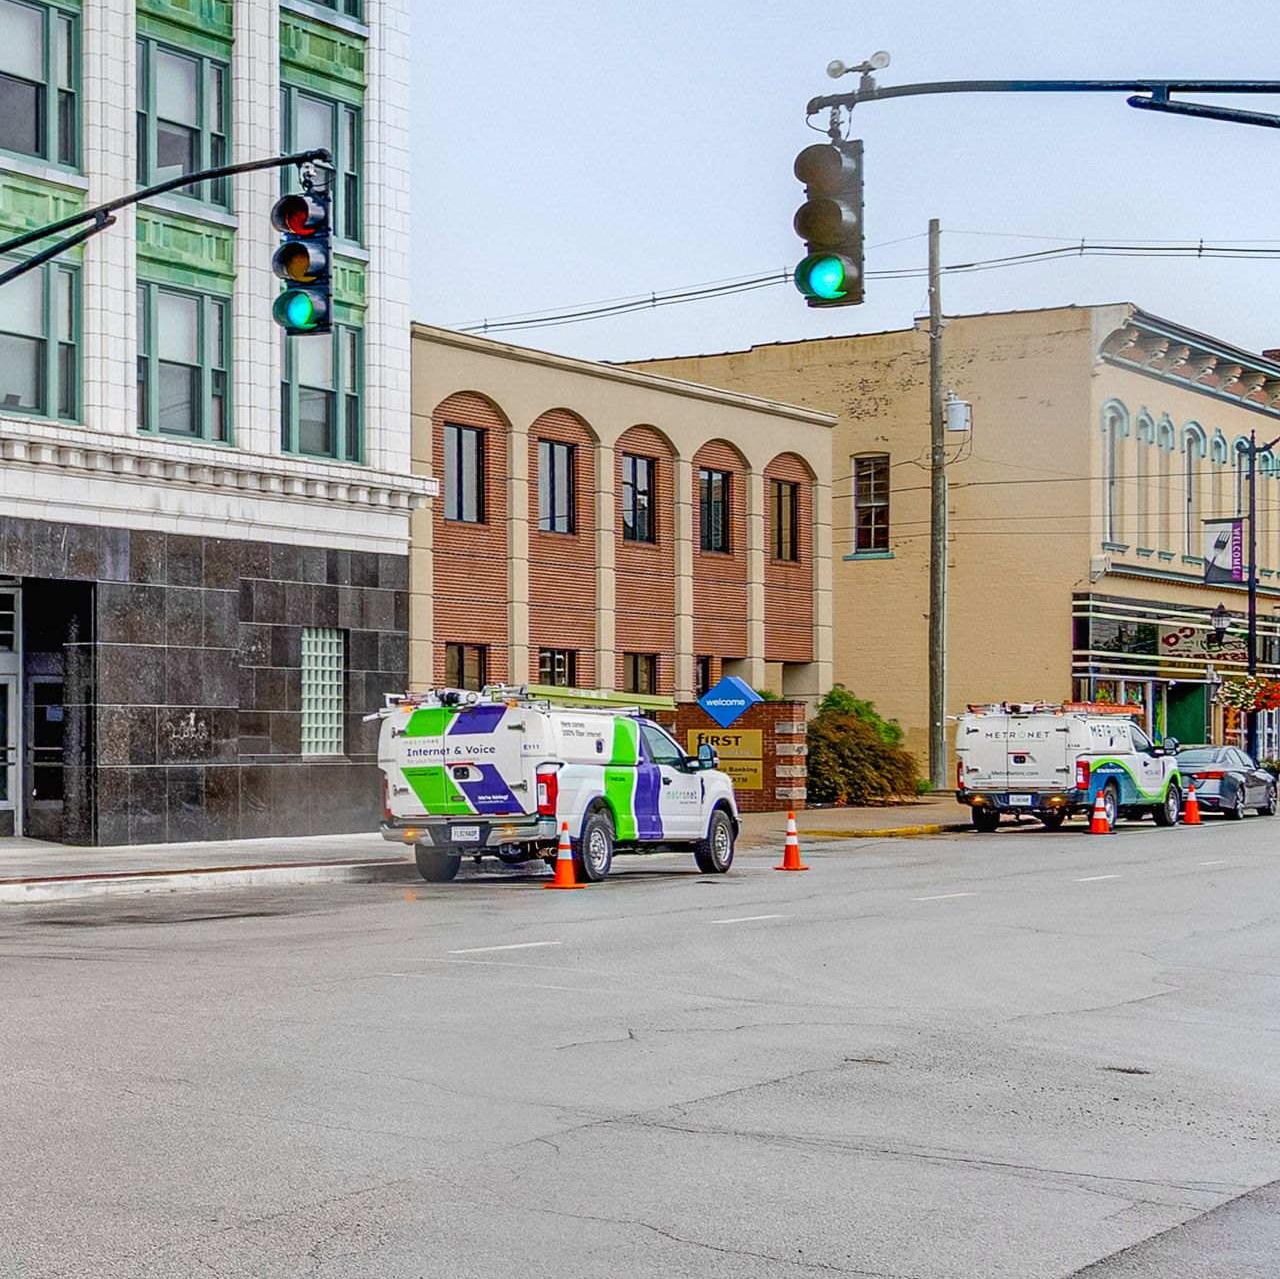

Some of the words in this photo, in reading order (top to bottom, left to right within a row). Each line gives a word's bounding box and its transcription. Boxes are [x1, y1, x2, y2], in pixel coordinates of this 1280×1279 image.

[706, 698, 746, 707] welcome
[985, 731, 1050, 739] METRONET
[407, 748, 450, 757] Internet
[454, 746, 462, 755] &
[465, 744, 496, 754] Voice
[729, 766, 758, 774] Banking
